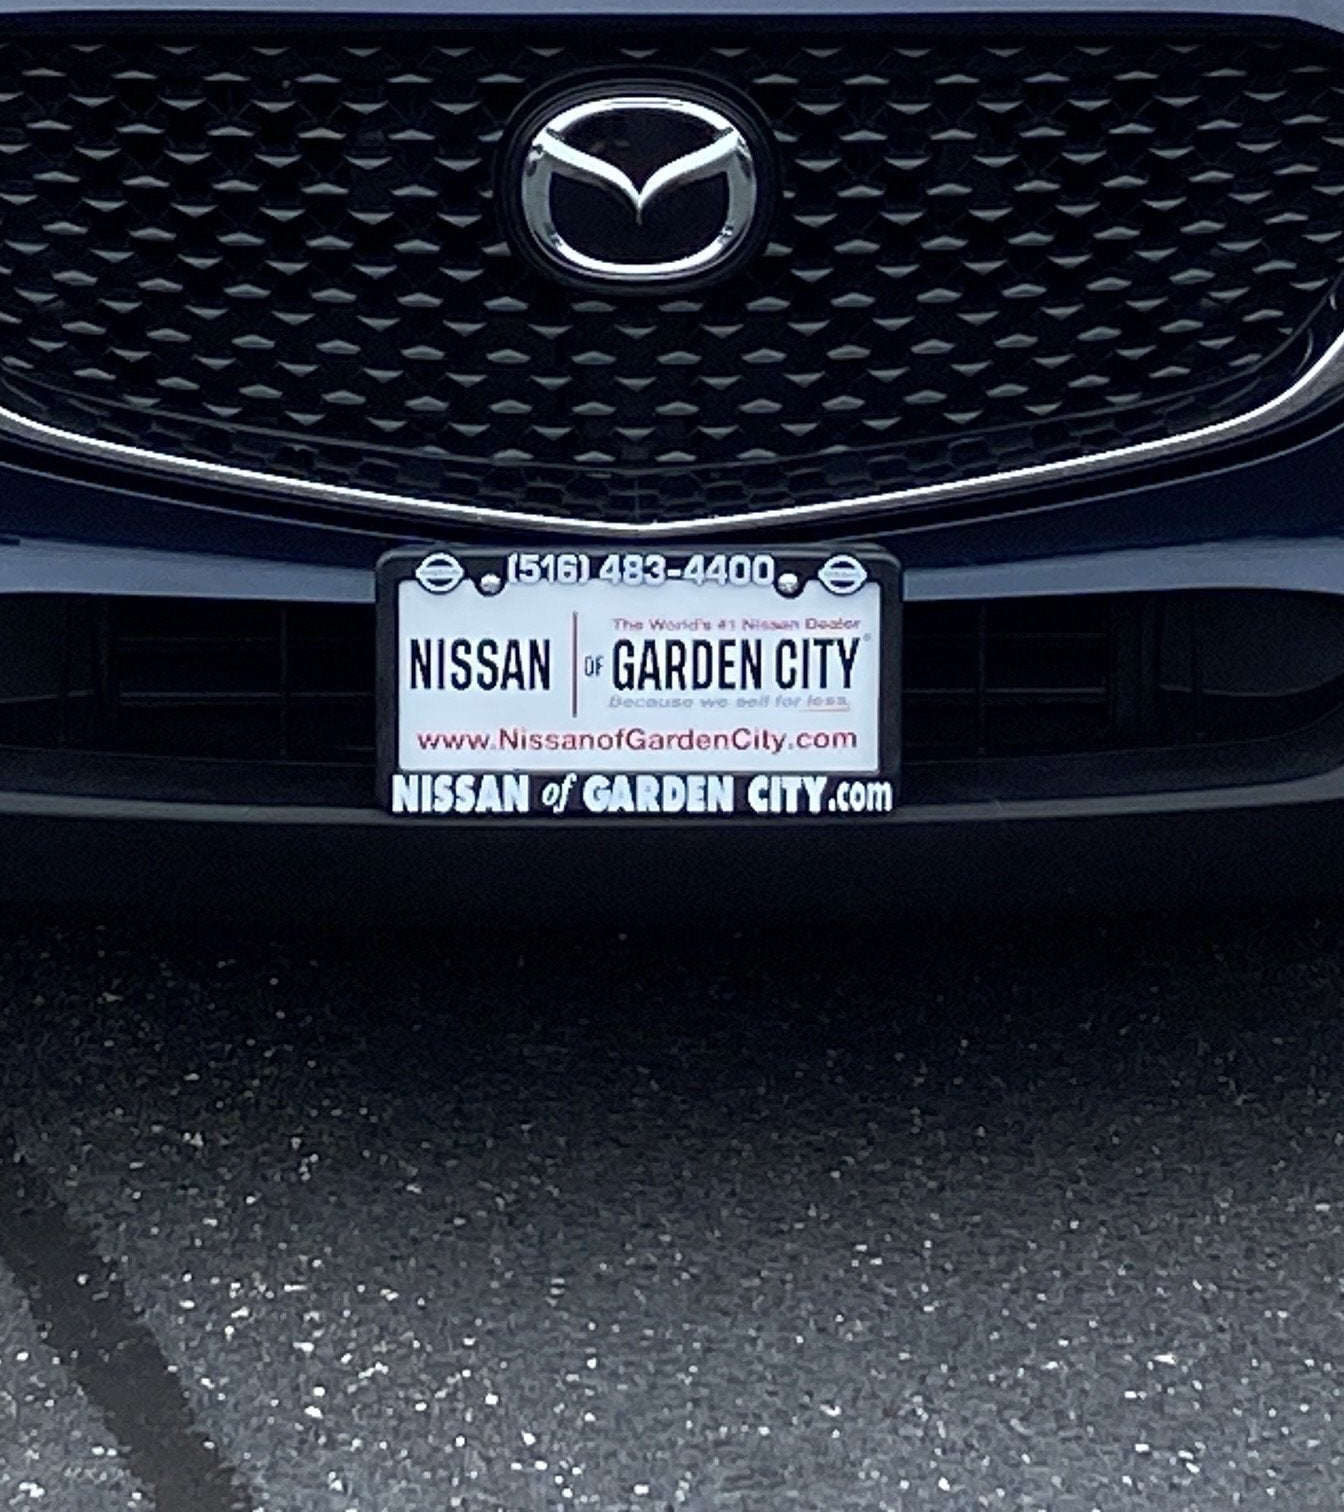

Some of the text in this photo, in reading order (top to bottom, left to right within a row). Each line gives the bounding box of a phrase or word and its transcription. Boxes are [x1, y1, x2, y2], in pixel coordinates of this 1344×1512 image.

[507, 551, 776, 586] (516) 483-4400
[613, 617, 644, 632] The
[649, 617, 712, 632] World's
[742, 618, 800, 632] Nissan
[805, 618, 862, 631] Dealer
[410, 638, 862, 691] NISSAN OF GARDEN CITY
[608, 694, 694, 709] Because
[699, 697, 729, 709] we
[773, 695, 802, 709] for
[416, 727, 858, 754] www.NissanofGardenCity.com
[391, 771, 894, 815] NISSAN of GARDEN CITY.com
